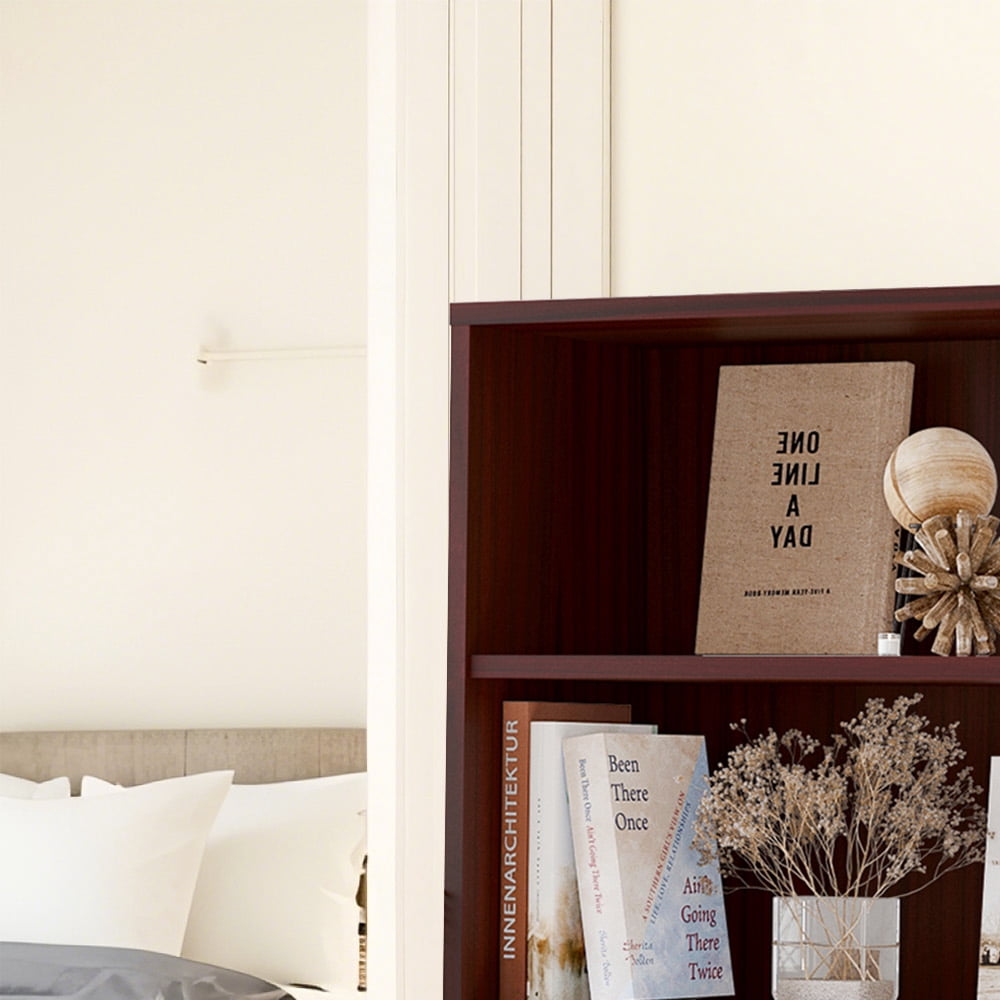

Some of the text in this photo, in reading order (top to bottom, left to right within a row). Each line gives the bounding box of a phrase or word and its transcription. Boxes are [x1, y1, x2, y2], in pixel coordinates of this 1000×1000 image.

[608, 755, 640, 773] Been
[611, 783, 648, 802] There
[615, 812, 648, 831] Once
[503, 719, 519, 959] INNENARCHITEKTUR
[681, 905, 717, 928] Going
[685, 932, 720, 951] There
[688, 961, 723, 980] Twice
